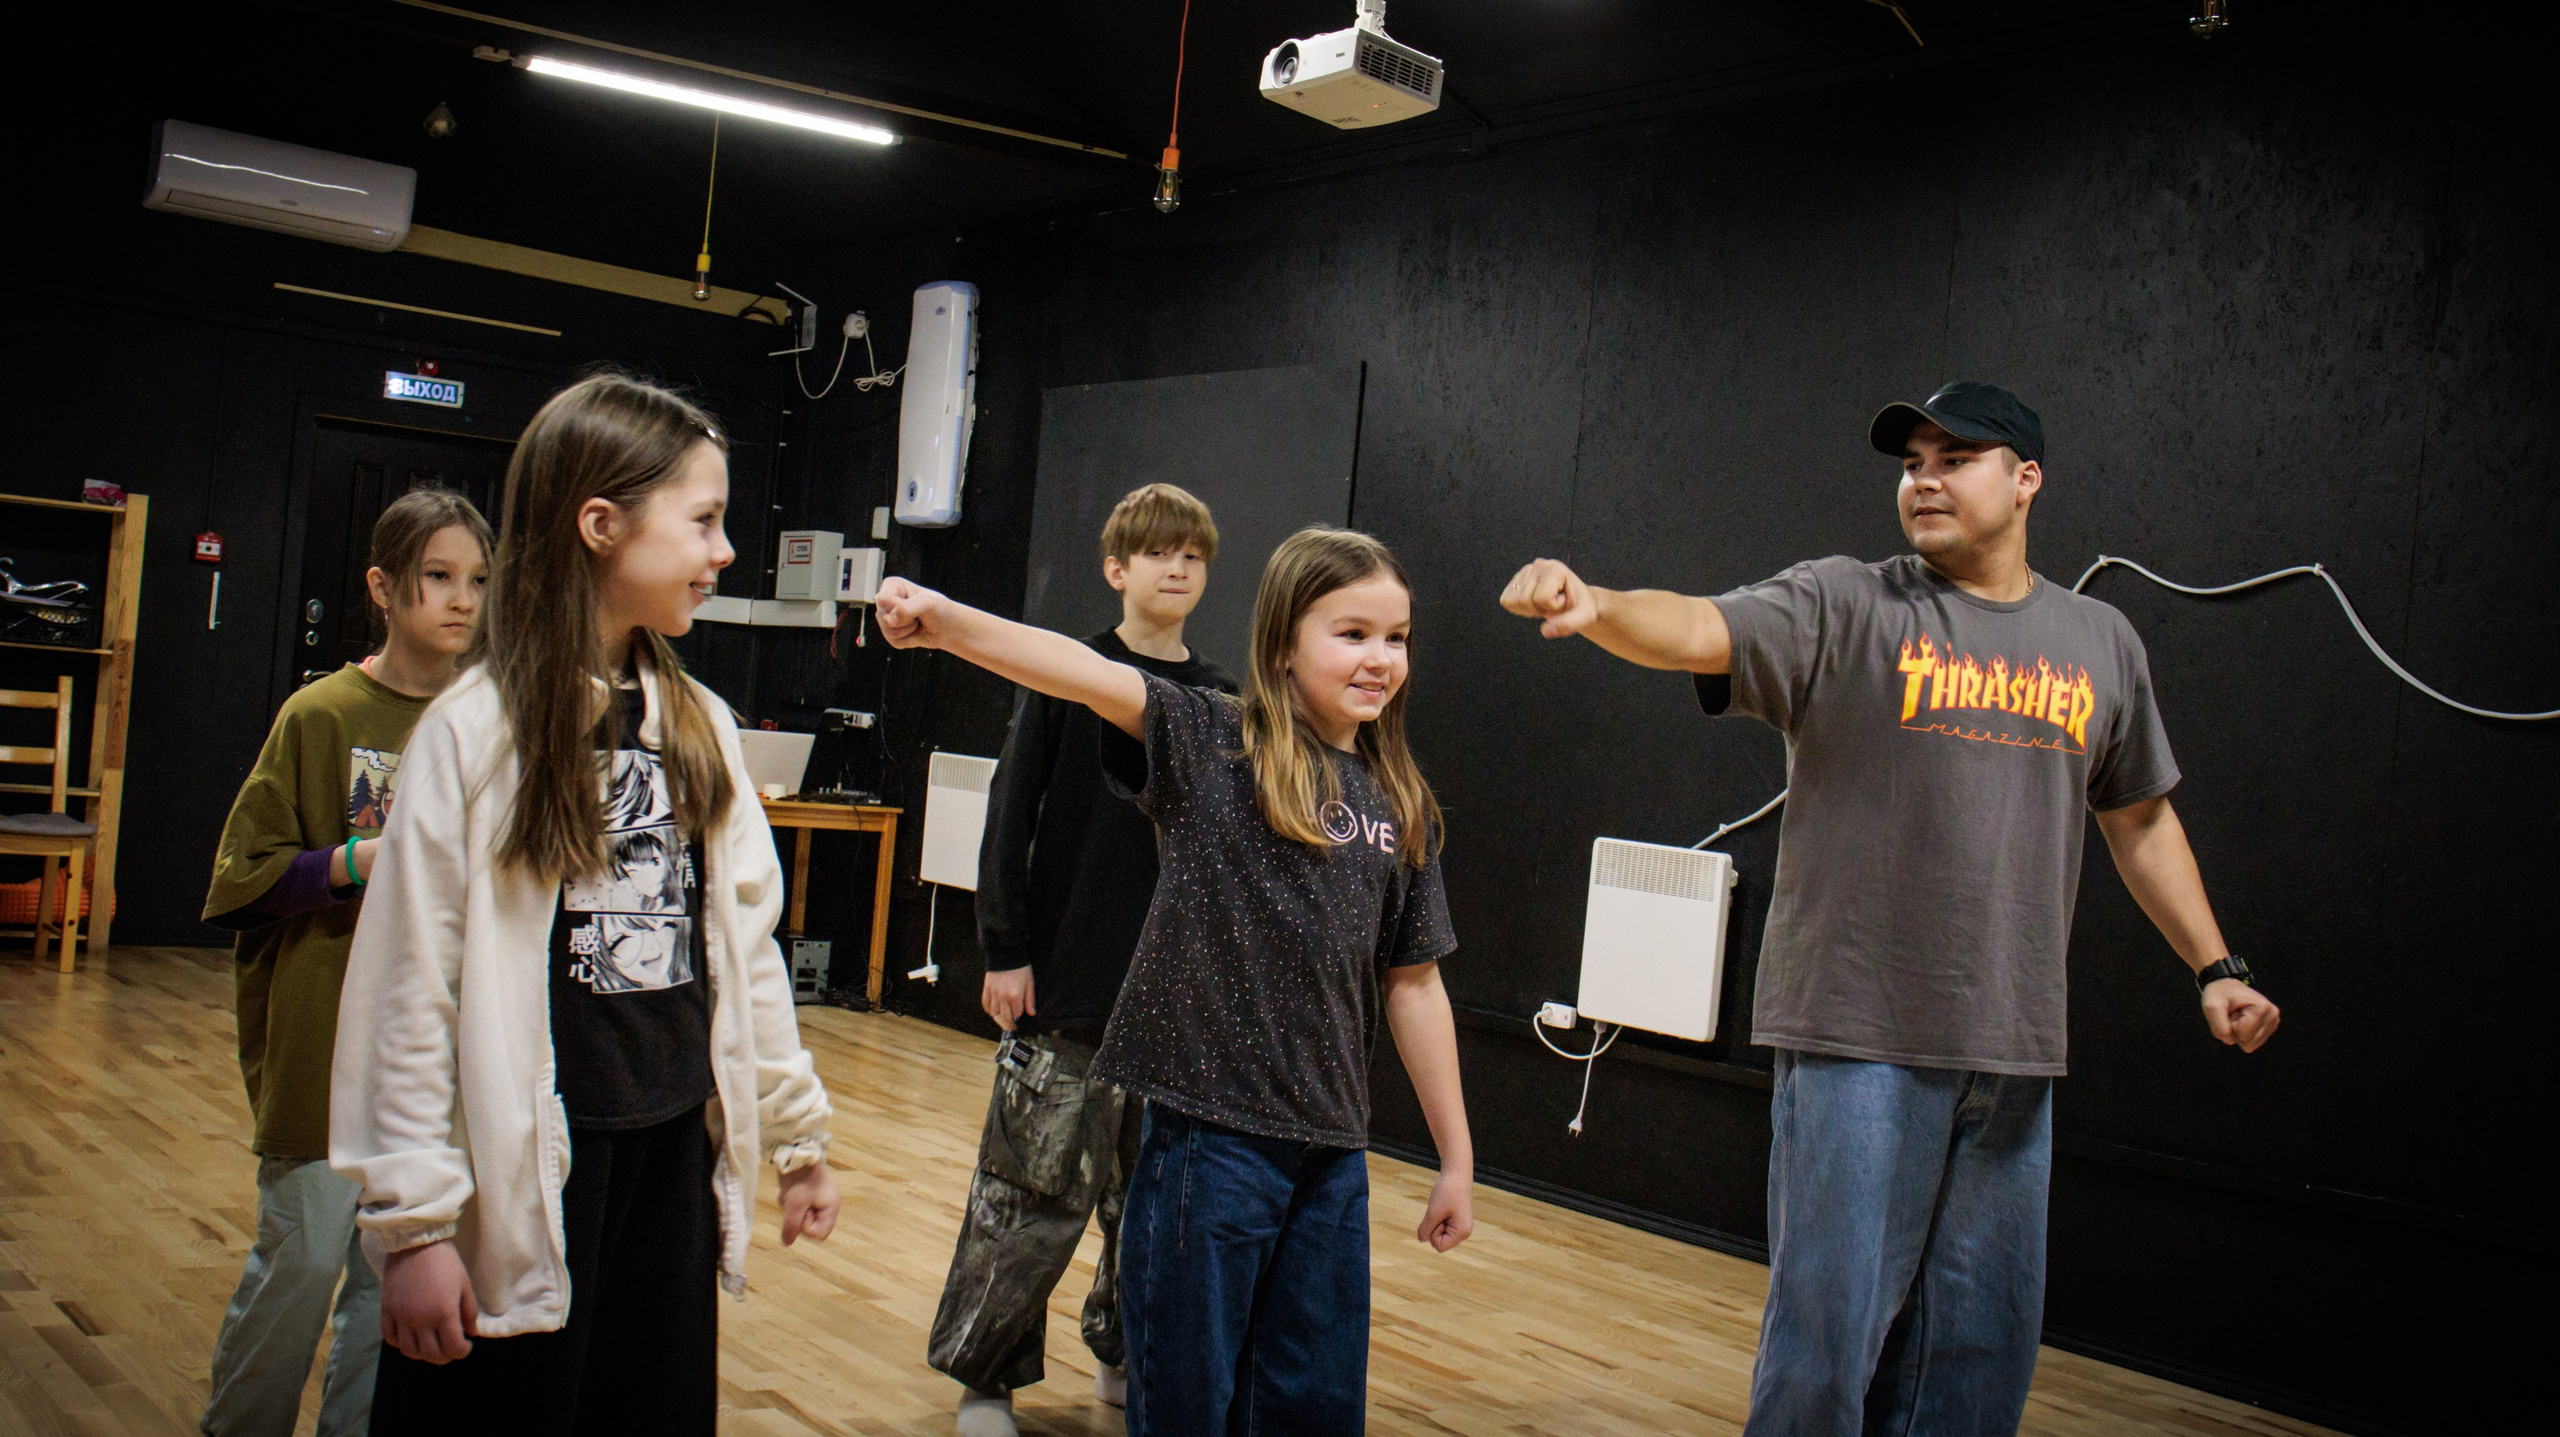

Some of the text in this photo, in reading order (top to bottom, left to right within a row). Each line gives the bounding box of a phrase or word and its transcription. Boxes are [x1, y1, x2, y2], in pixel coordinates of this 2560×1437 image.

[388, 377, 456, 402] ВЫХОД
[1898, 631, 2095, 749] THRASHER
[1929, 722, 2063, 750] MAGAZINE
[569, 924, 600, 983] 感心
